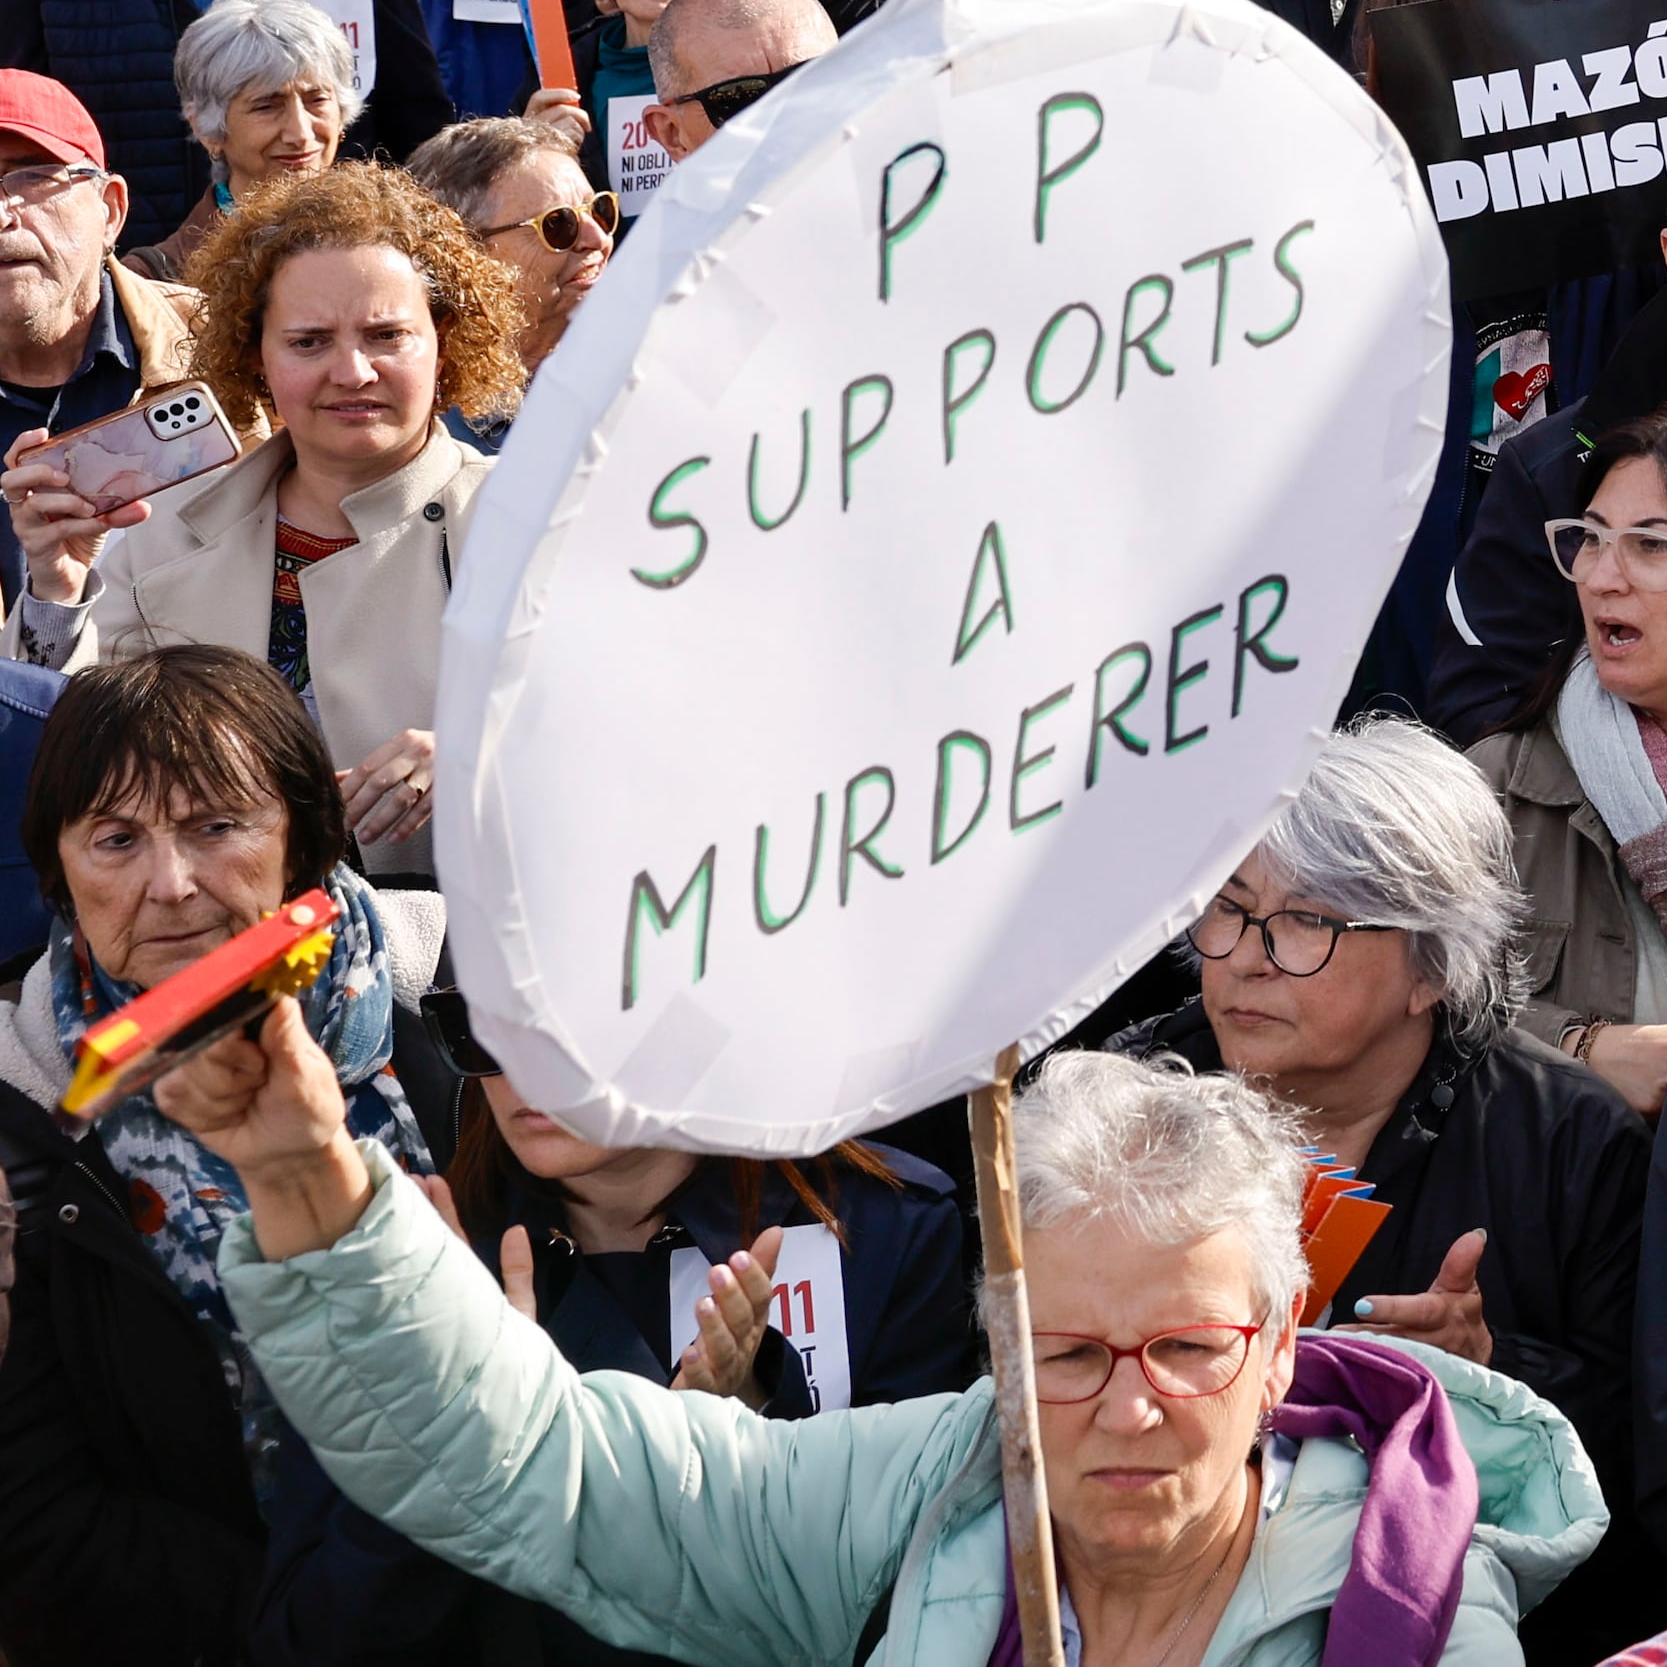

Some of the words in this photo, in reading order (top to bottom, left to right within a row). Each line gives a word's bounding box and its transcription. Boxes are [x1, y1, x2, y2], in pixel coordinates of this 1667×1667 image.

[621, 156, 635, 174] NI
[621, 177, 634, 194] NI
[629, 220, 1315, 589] SUPPORTS
[950, 521, 1013, 667] A
[620, 572, 1300, 1011] MURDERER
